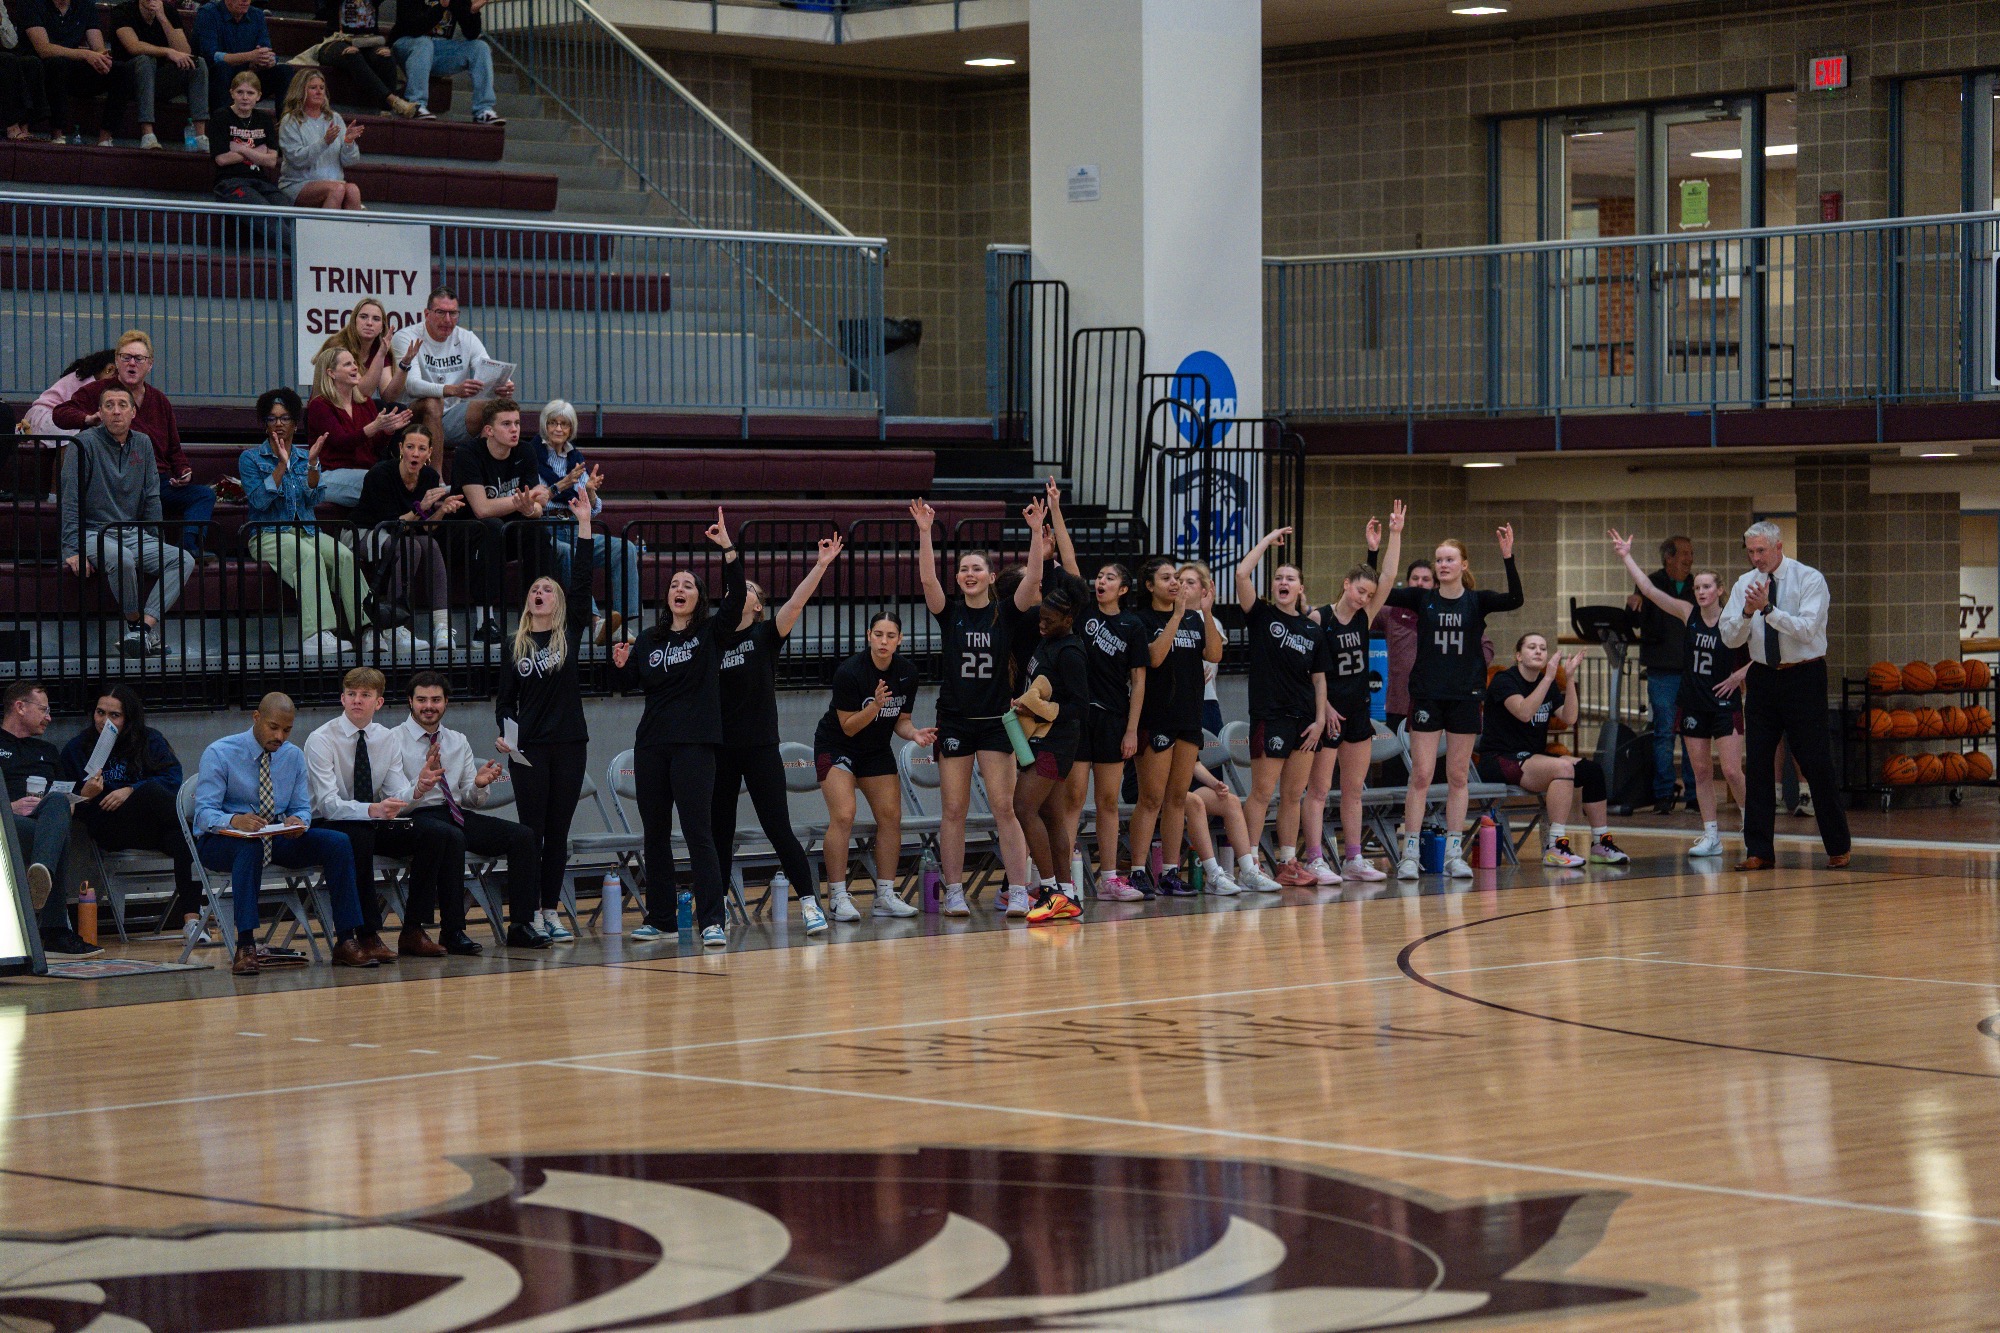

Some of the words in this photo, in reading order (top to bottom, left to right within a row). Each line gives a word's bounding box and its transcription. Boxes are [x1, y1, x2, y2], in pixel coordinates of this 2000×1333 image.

[1815, 58, 1843, 86] EXIT
[309, 266, 418, 296] TRINITY
[306, 308, 422, 337] SECON
[1178, 398, 1237, 423] NCAA
[1438, 612, 1462, 627] TRN
[965, 632, 991, 648] TRN
[1096, 635, 1118, 656] TIGERS
[1336, 631, 1361, 649] TRN
[1434, 630, 1464, 655] 44
[1695, 632, 1717, 650] TRN
[666, 650, 693, 666] TIGERS
[961, 652, 993, 679] 22
[1337, 650, 1365, 676] 23
[1693, 650, 1713, 675] 12
